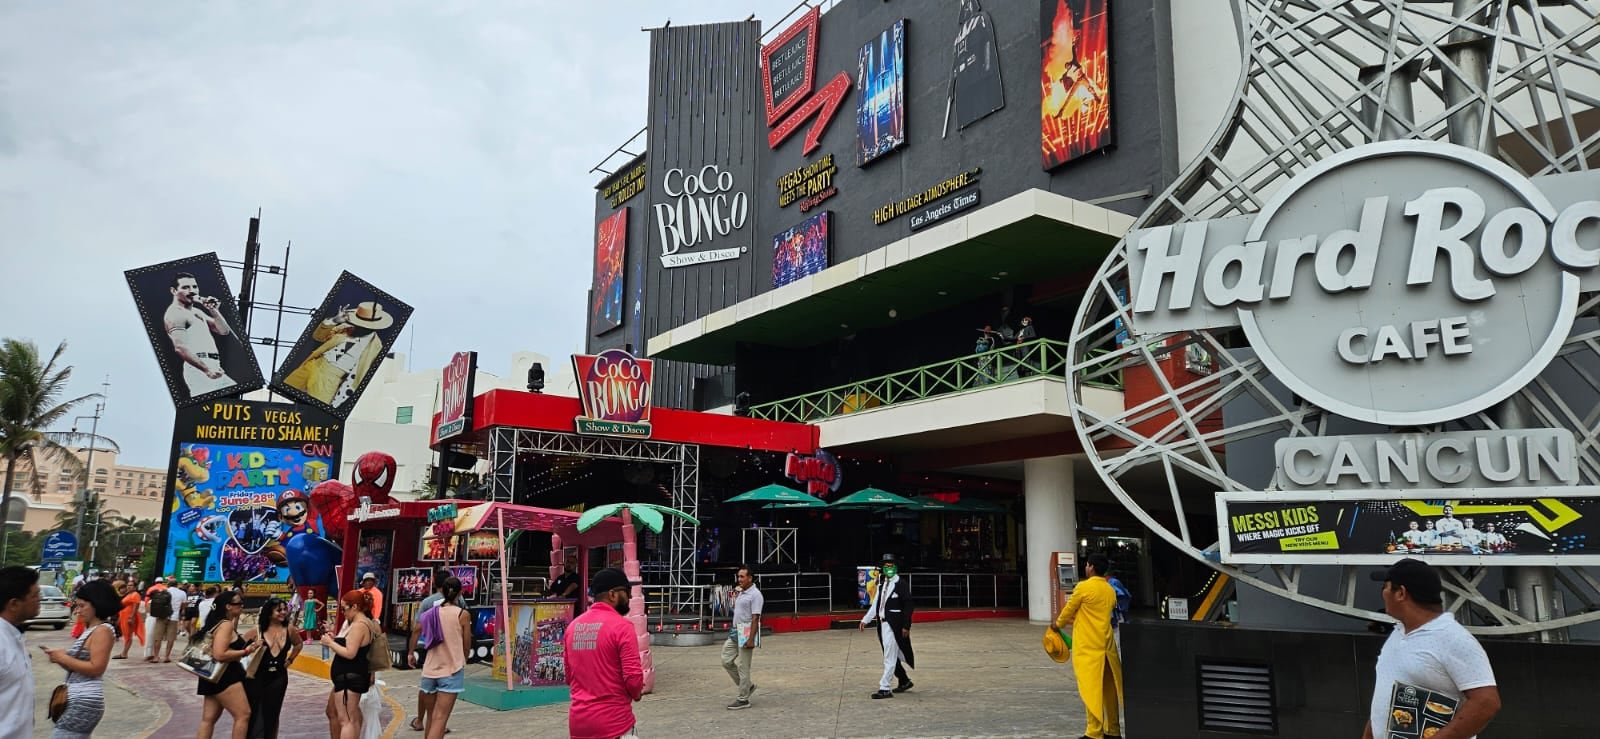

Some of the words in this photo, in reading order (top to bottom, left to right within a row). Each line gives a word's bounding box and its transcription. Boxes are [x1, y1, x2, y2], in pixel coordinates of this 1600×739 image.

[772, 36, 805, 71] BEETLEJUICE
[773, 53, 805, 85] BEETLEJUICE
[803, 153, 832, 180] SHOWTIME
[779, 190, 796, 207] MEETS
[796, 182, 807, 199] THE
[895, 193, 922, 216] VOLTAGE
[910, 216, 923, 228] Los
[925, 203, 952, 223] Angeles
[953, 192, 977, 210] Times
[653, 191, 748, 257] BONGO
[669, 255, 695, 266] Show
[697, 253, 706, 262] &
[709, 251, 736, 260] Disco
[1134, 196, 1389, 313] Hard
[1337, 315, 1474, 364] CAFE
[443, 374, 468, 425] BONGO
[587, 375, 650, 420] BONGO
[264, 410, 302, 425] VEGAS
[585, 422, 610, 431] Show
[611, 424, 620, 433] &
[621, 424, 646, 434] Disco
[196, 425, 257, 440] NIGHTLIFE
[261, 427, 275, 440] TO
[227, 450, 280, 470] KIDS
[302, 443, 332, 457] CNN
[1283, 435, 1571, 485] CANCUN
[216, 468, 291, 491] PARTY
[220, 496, 250, 506] June
[252, 492, 275, 504] 28th
[1232, 511, 1280, 533] MESSI
[1281, 505, 1320, 527] KIDS
[1237, 531, 1262, 542] WHERE
[1262, 528, 1285, 539] MAGIC
[1285, 526, 1306, 536] KICKS
[1306, 524, 1320, 533] OFF
